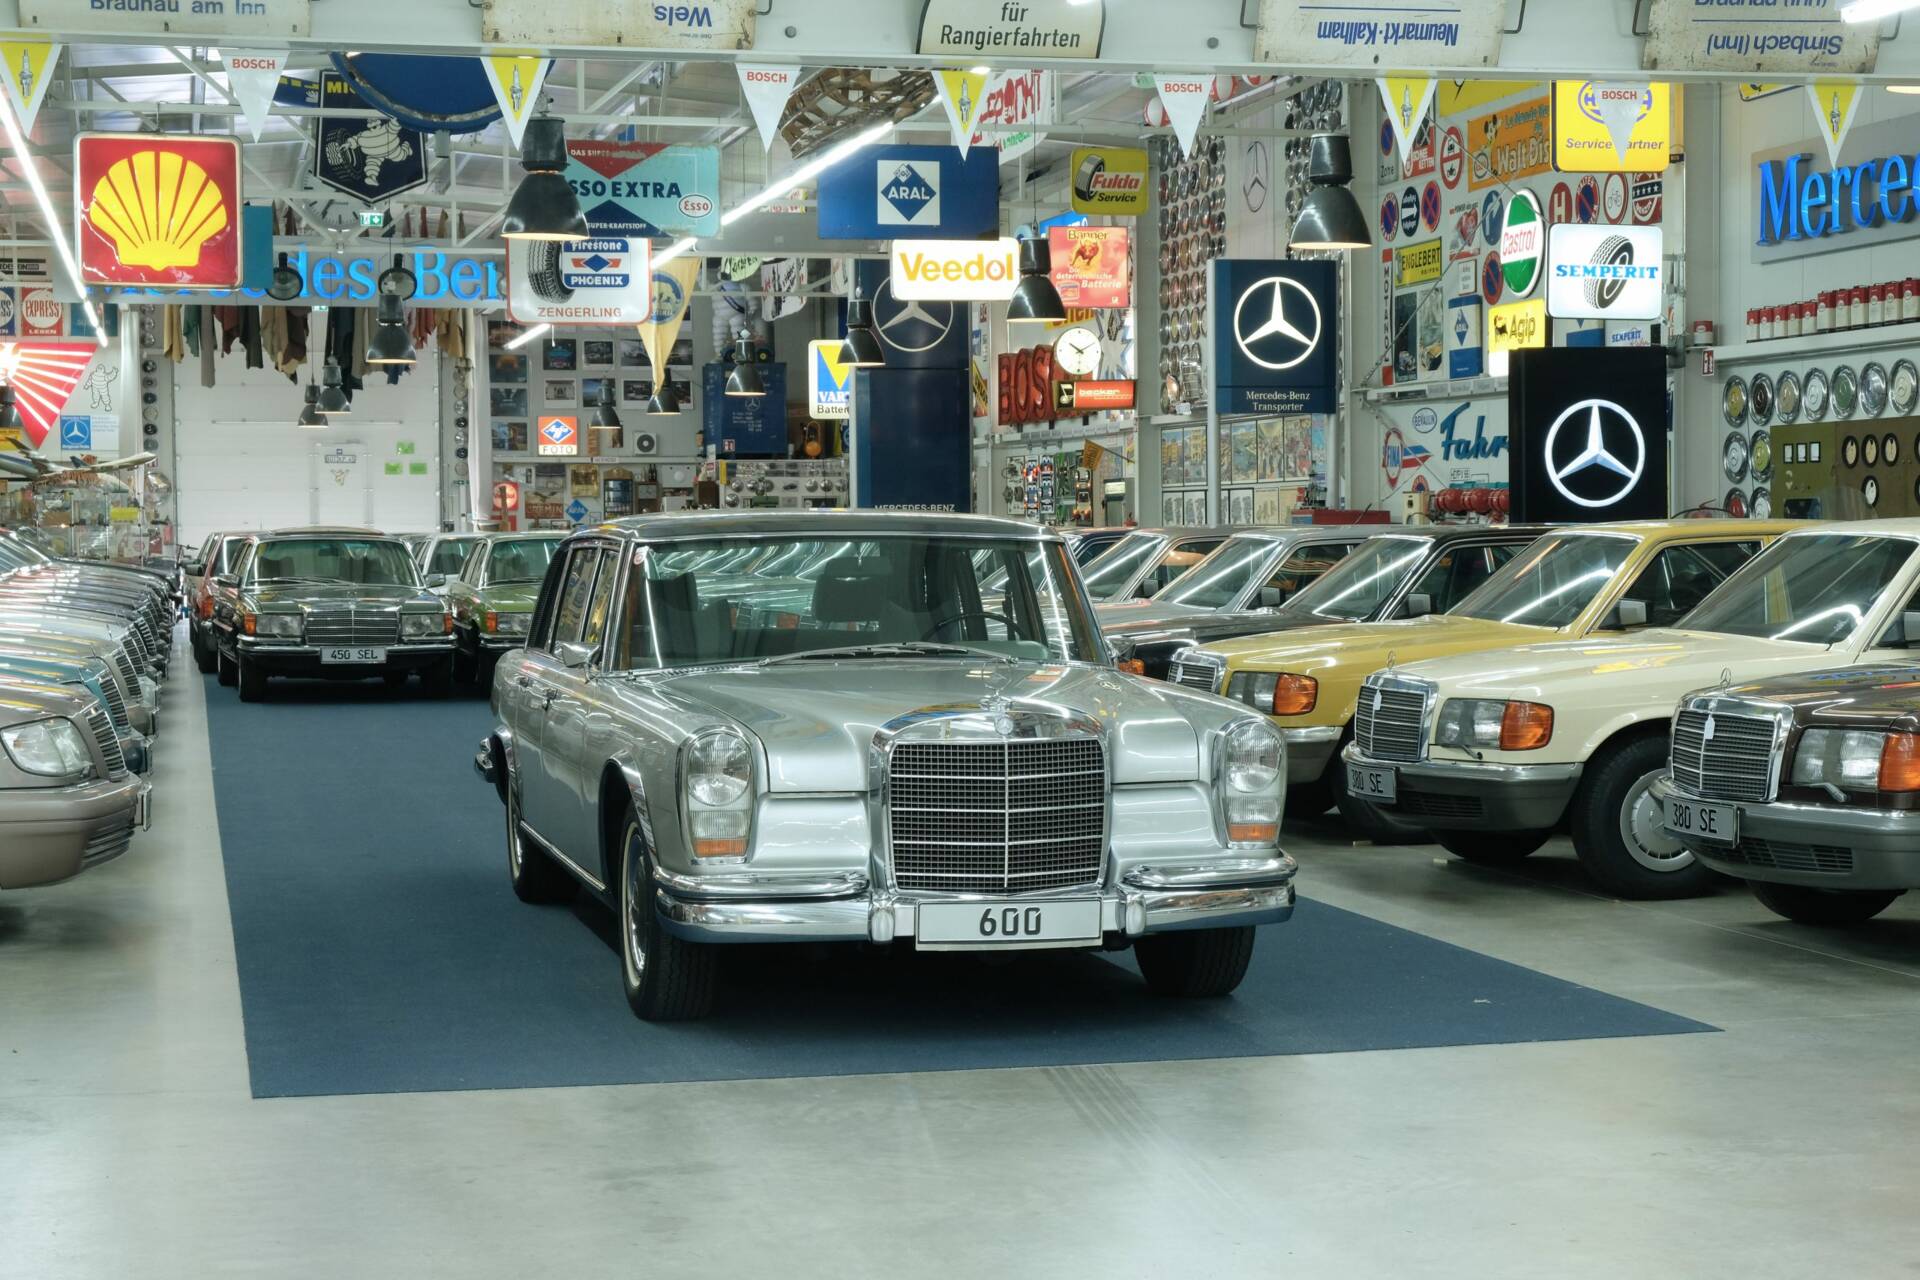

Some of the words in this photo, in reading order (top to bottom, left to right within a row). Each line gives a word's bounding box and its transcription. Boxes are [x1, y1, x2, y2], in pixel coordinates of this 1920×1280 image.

[191, 1, 223, 14] am
[235, 0, 265, 15] Inn
[1001, 2, 1029, 22] für
[654, 6, 713, 27] Wels
[940, 25, 1080, 50] Rangierfahrten
[1706, 34, 1750, 56] (Inn)
[1753, 34, 1843, 55] Simbach
[232, 58, 276, 70] BOSCH
[746, 70, 787, 84] BOSCH
[1164, 83, 1202, 93] BOSCH
[1601, 90, 1637, 100] BOSCH
[1528, 136, 1550, 167] Dis
[1566, 138, 1613, 150] Service
[1626, 140, 1664, 150] artner
[1092, 173, 1140, 189] Fulda
[568, 180, 607, 197] SSO
[611, 181, 682, 198] EXTRA
[888, 186, 930, 200] ARAL
[1098, 192, 1137, 203] Service
[1068, 230, 1108, 240] Banner
[1503, 226, 1536, 256] Castrol
[899, 252, 1014, 281] Veedol
[1402, 247, 1440, 271] ENGLEBERT
[1556, 264, 1659, 279] SEMPERIT
[571, 276, 623, 285] PHOENIX
[1081, 280, 1121, 289] Batterie
[25, 300, 60, 318] EXPRESS
[537, 306, 623, 318] ZENGERLING
[1509, 315, 1536, 343] Agip
[1246, 391, 1311, 400] Mercedes-Benz
[1253, 402, 1304, 412] Transporter
[543, 446, 574, 454] FOTO
[331, 649, 350, 660] 450
[357, 649, 378, 660] SEL
[1369, 772, 1384, 793] SE
[1672, 803, 1691, 829] 380
[1699, 808, 1717, 833] SE
[979, 907, 1042, 936] 600
